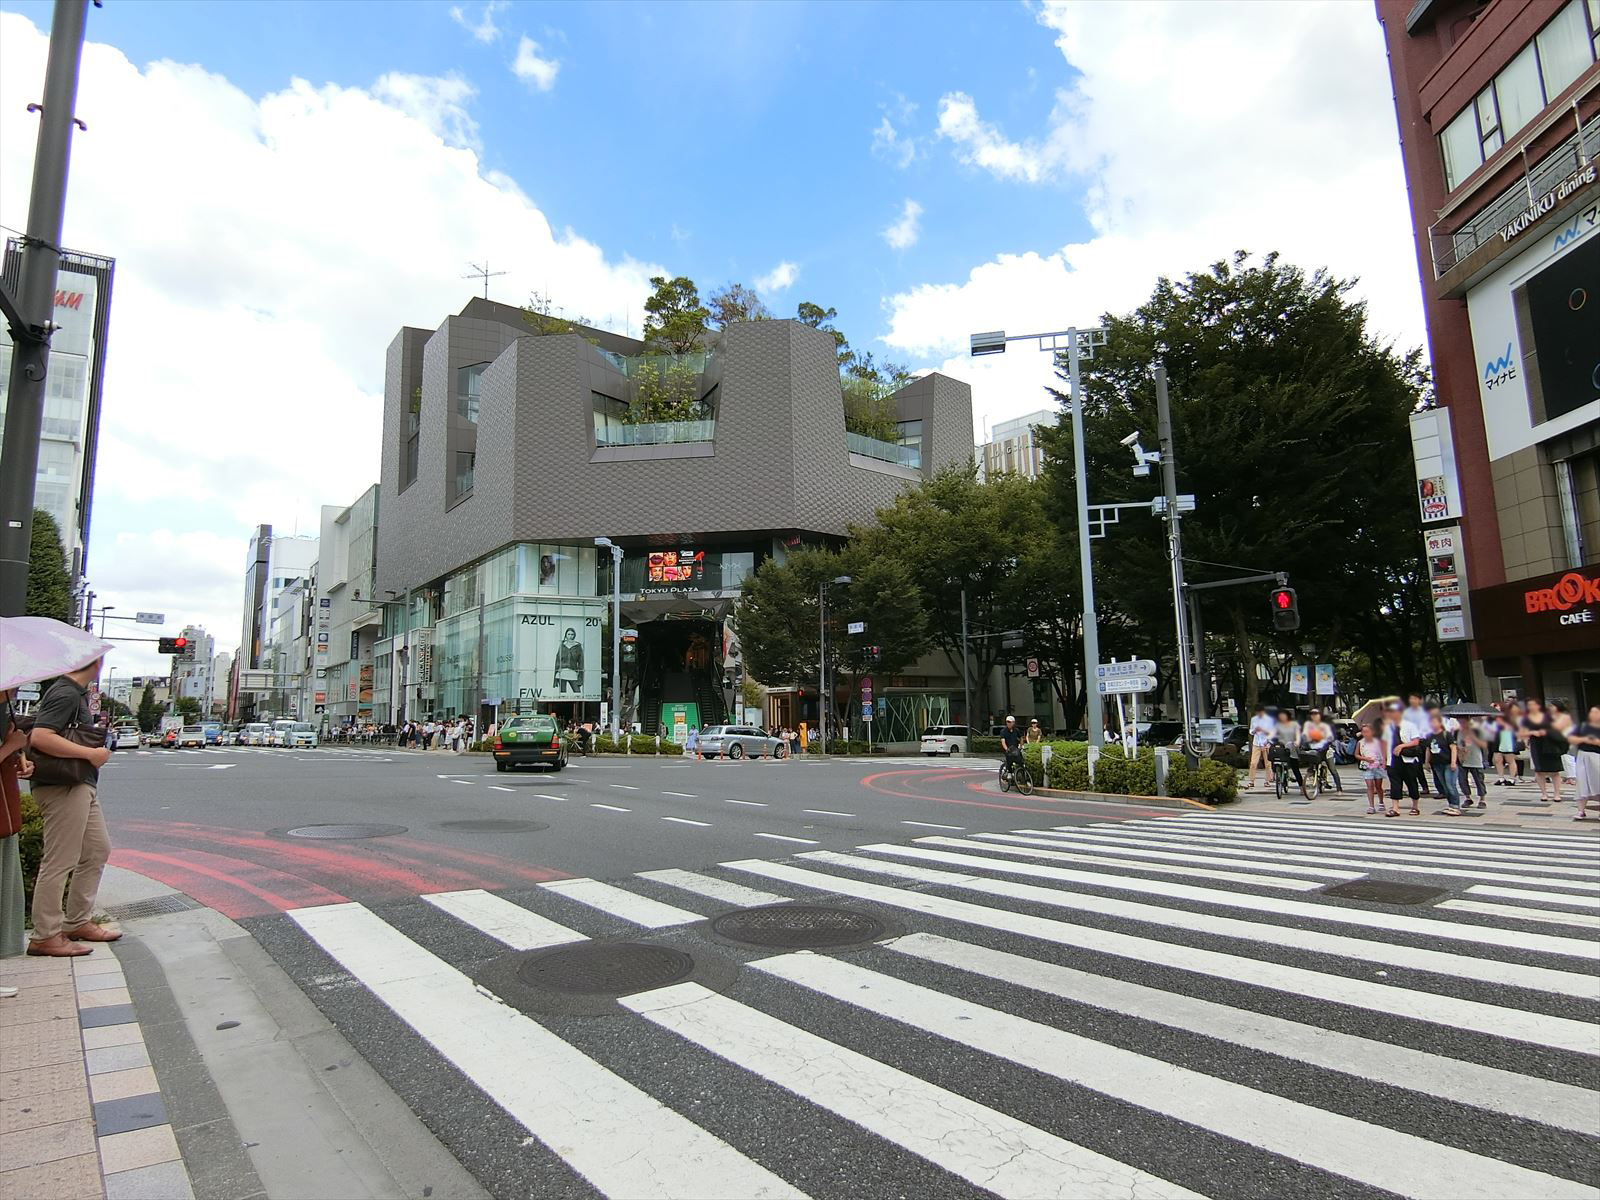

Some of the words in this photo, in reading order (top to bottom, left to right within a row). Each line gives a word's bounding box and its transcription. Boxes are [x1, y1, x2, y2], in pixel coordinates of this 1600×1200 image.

[1499, 195, 1555, 242] YAKINIKU
[1557, 165, 1597, 200] dining
[1582, 205, 1600, 226] マ
[1485, 367, 1517, 390] マイナビ
[1428, 538, 1452, 550] 焼肉
[521, 615, 555, 626] AZUL
[1559, 609, 1592, 625] CAFÉ
[519, 688, 542, 698] F/W
